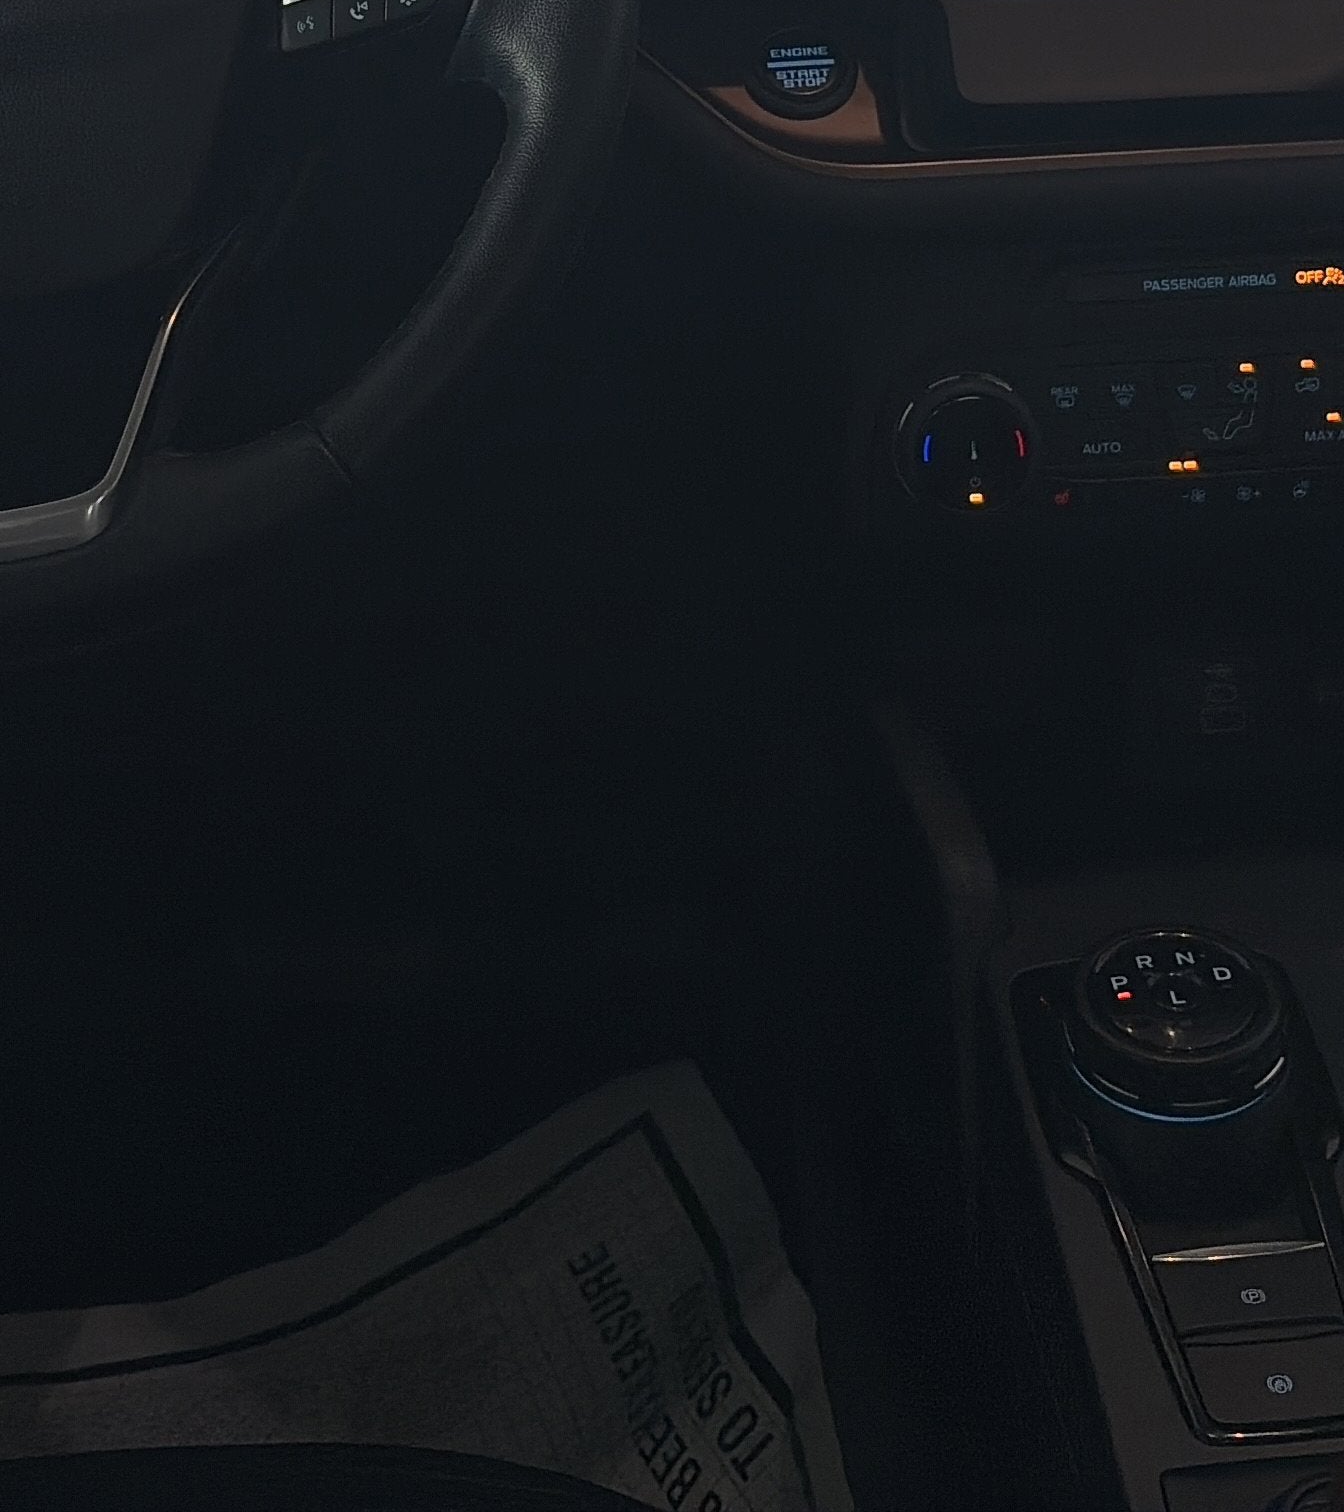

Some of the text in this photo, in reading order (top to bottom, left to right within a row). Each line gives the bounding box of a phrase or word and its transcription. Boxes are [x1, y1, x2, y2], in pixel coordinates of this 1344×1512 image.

[769, 45, 829, 59] ENGINE
[776, 68, 830, 80] START
[783, 77, 827, 89] STOP
[1143, 269, 1324, 292] PASSENGER AIRBAG OFF
[1304, 430, 1334, 442] MAX
[1082, 441, 1121, 455] AUTO
[1135, 954, 1154, 969] R
[1175, 951, 1196, 966] N
[1212, 966, 1233, 981] D
[1110, 975, 1129, 990] P
[1169, 990, 1187, 1005] L
[717, 1404, 774, 1482] TO
